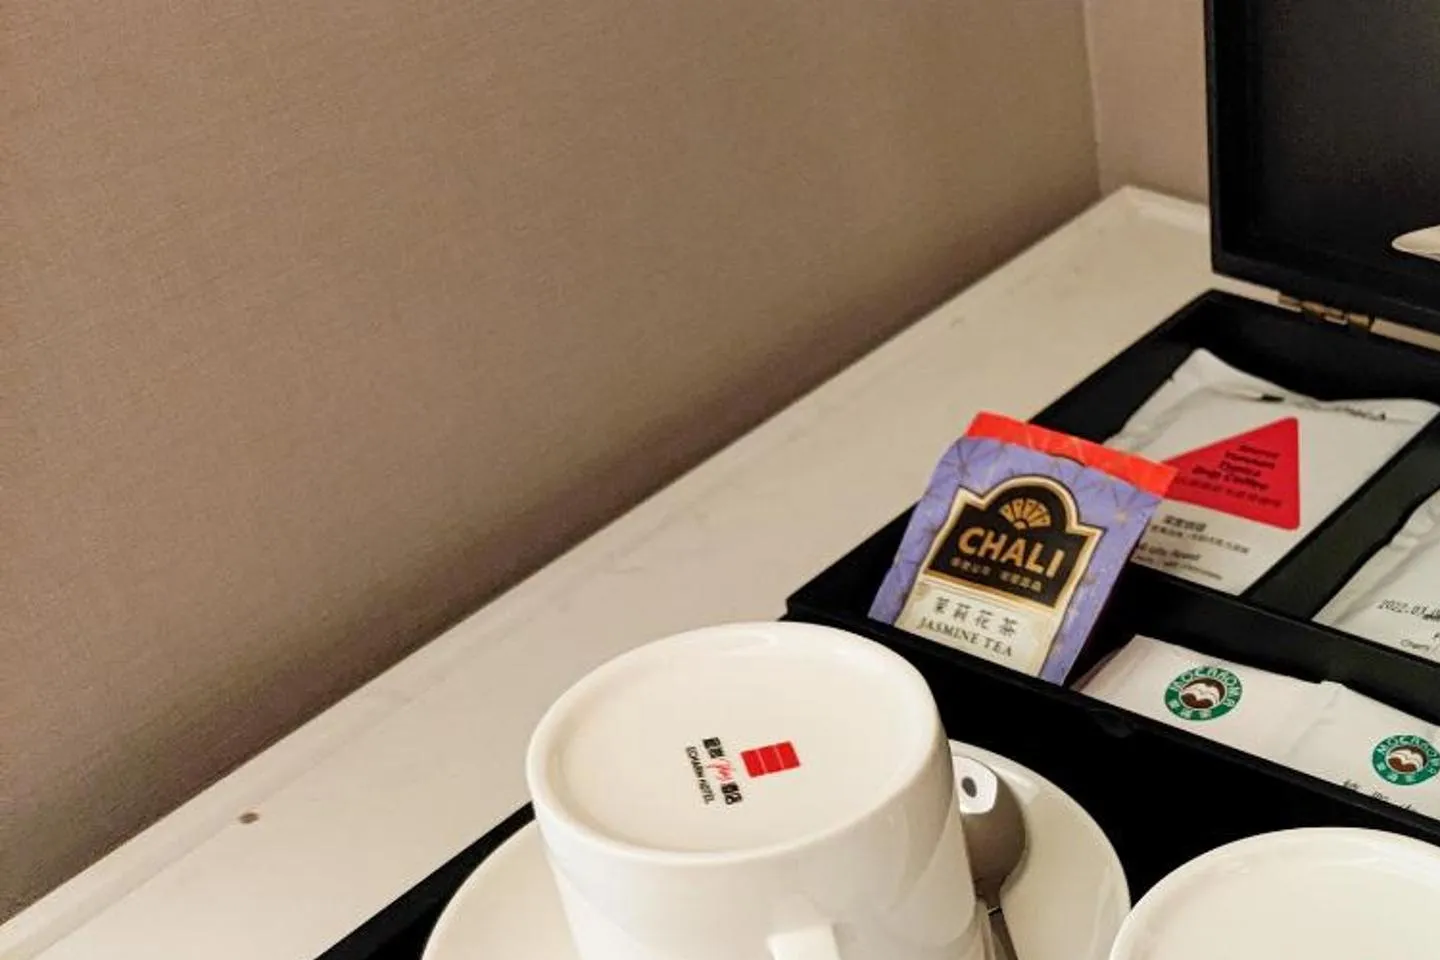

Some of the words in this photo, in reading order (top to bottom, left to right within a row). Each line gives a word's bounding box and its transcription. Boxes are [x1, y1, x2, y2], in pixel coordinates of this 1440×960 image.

[958, 526, 1065, 578] CHALI
[916, 615, 981, 645] JASMINE
[983, 635, 1014, 658] TEA
